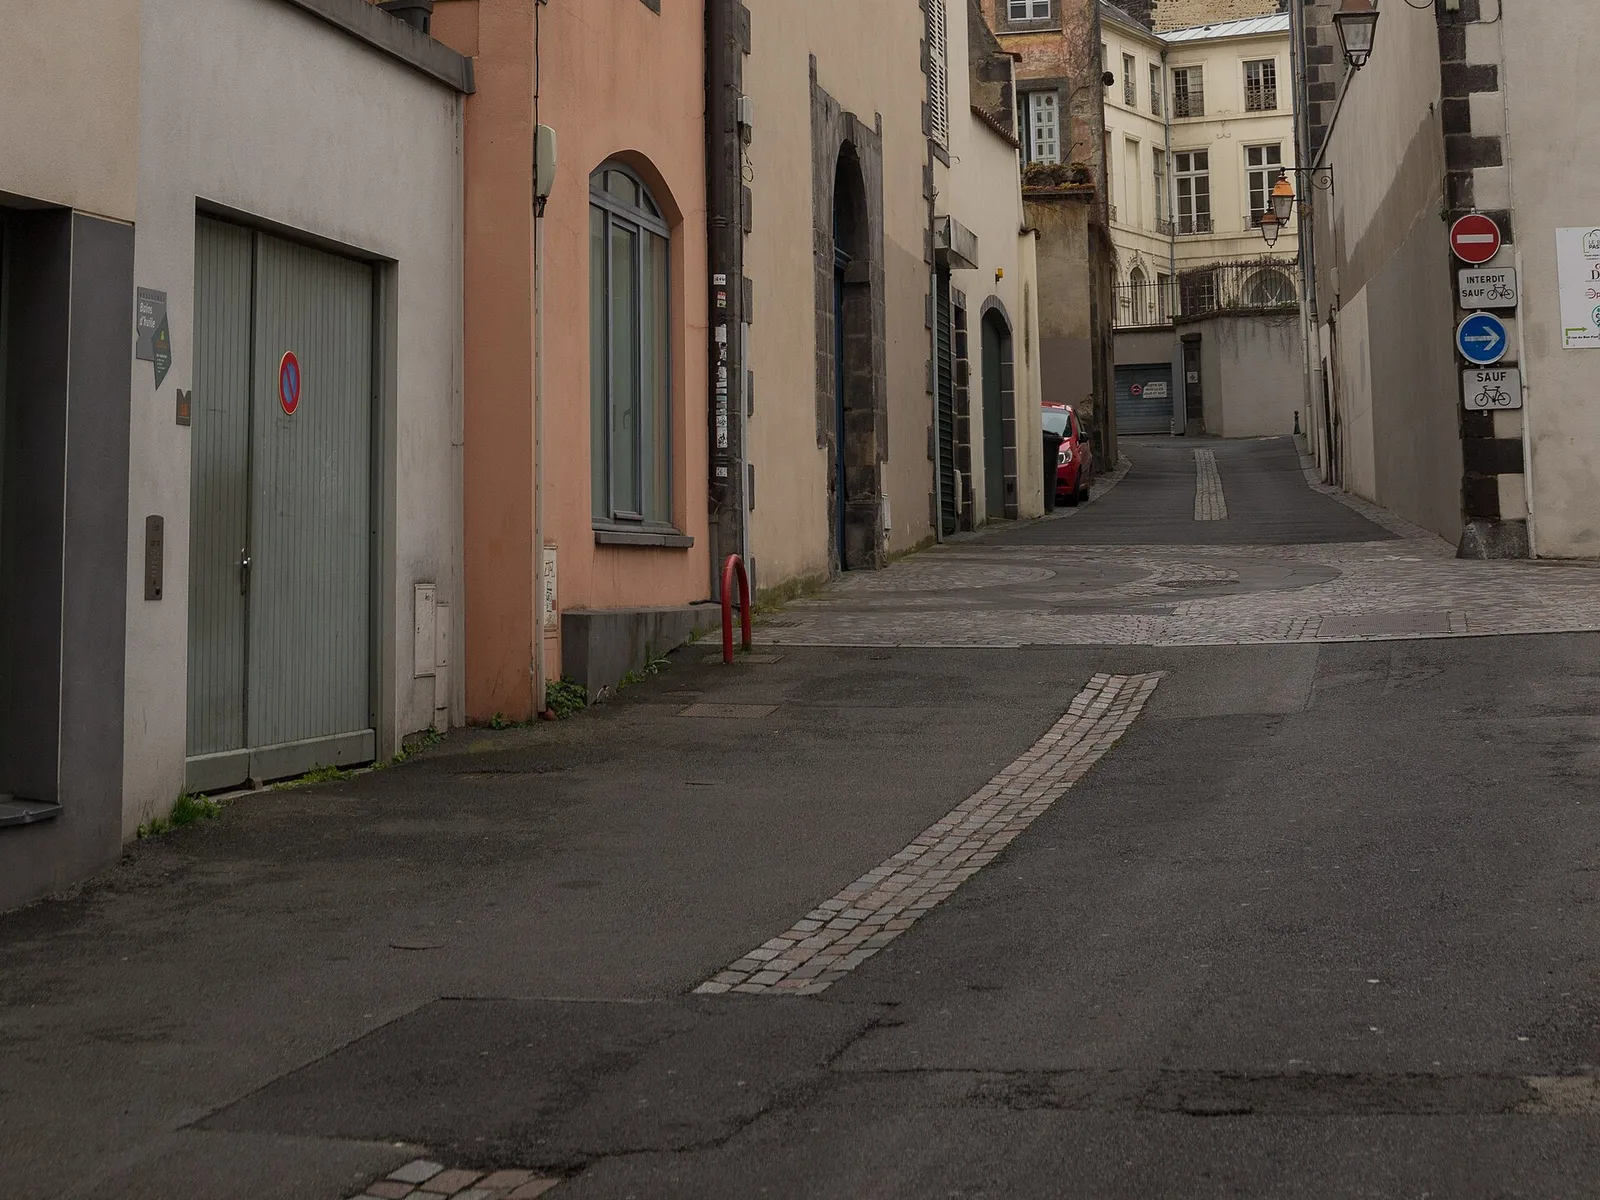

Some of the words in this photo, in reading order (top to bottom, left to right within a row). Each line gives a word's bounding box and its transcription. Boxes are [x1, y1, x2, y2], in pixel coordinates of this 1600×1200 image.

[1466, 274, 1505, 284] INTERDIT
[1461, 288, 1485, 298] SAUF
[139, 301, 153, 315] Bains
[139, 315, 156, 328] d'huile
[1476, 371, 1507, 383] SAUF
